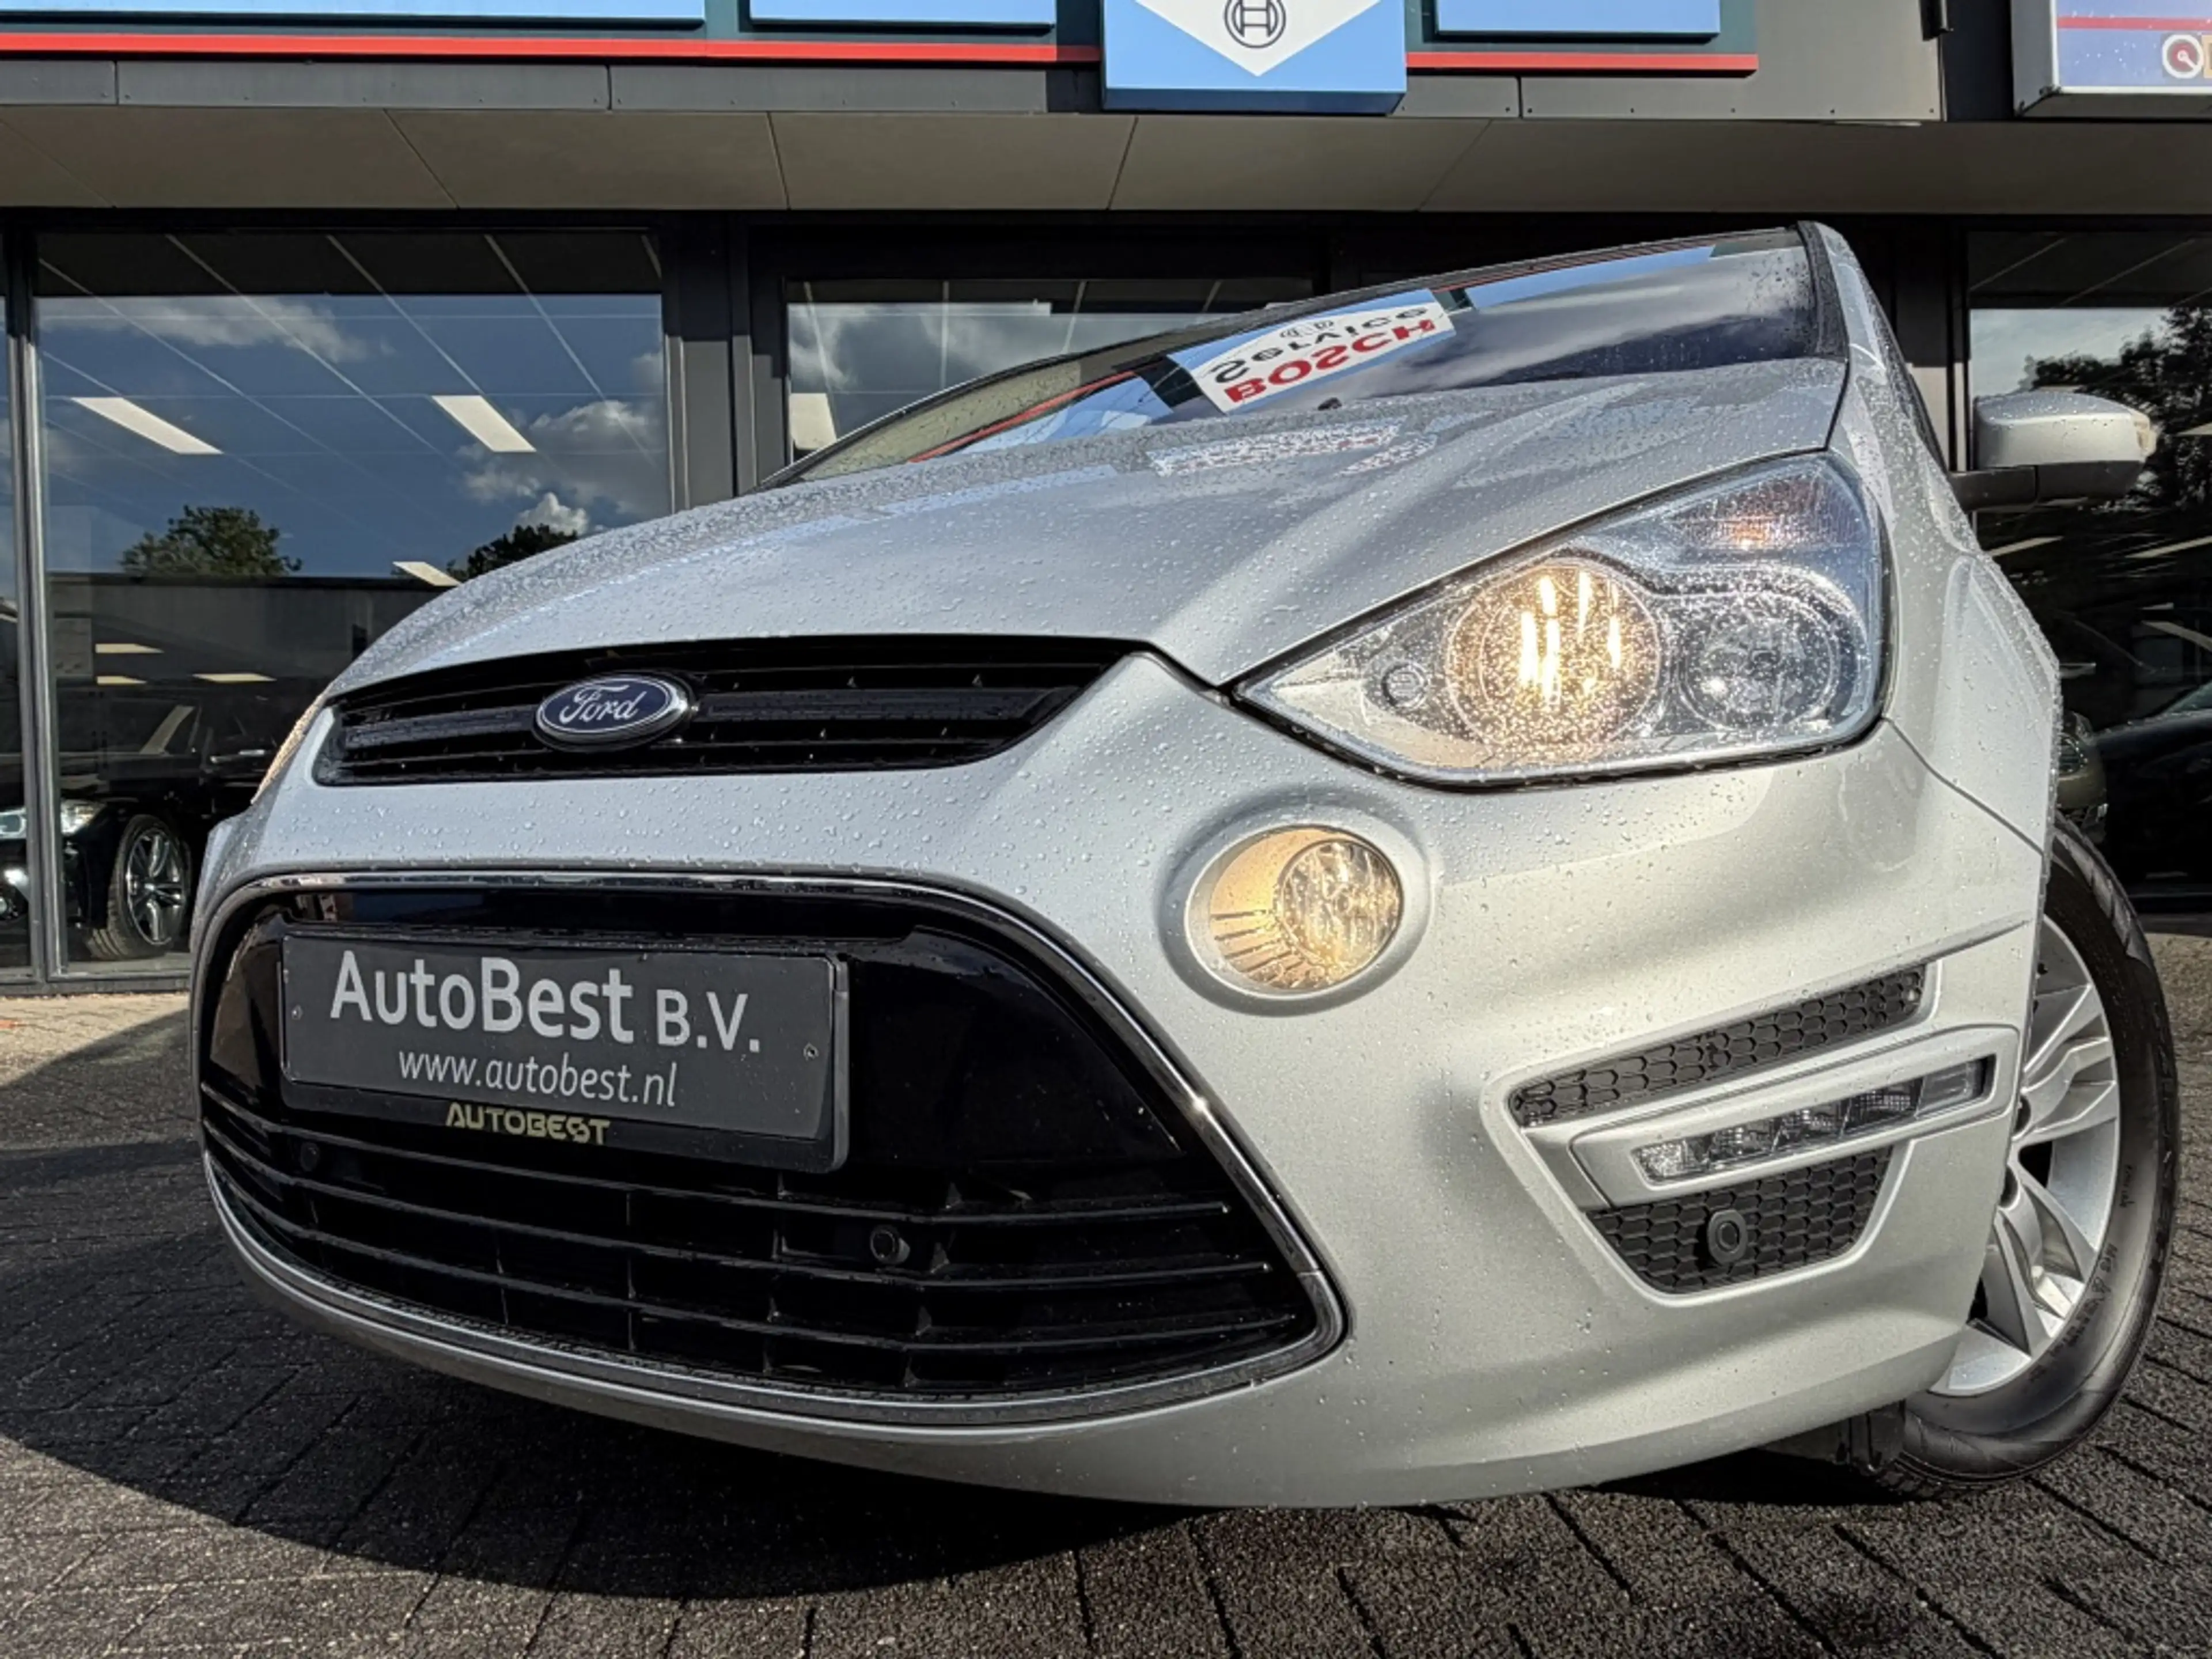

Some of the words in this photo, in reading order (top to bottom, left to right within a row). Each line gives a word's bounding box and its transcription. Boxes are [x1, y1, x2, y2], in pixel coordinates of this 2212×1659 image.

[559, 684, 647, 725] Ford
[330, 950, 634, 1044] AutoBest
[656, 988, 760, 1053] B.V.
[399, 1050, 677, 1107] www.autobest.nl
[445, 1101, 611, 1145] AUTOBEST
